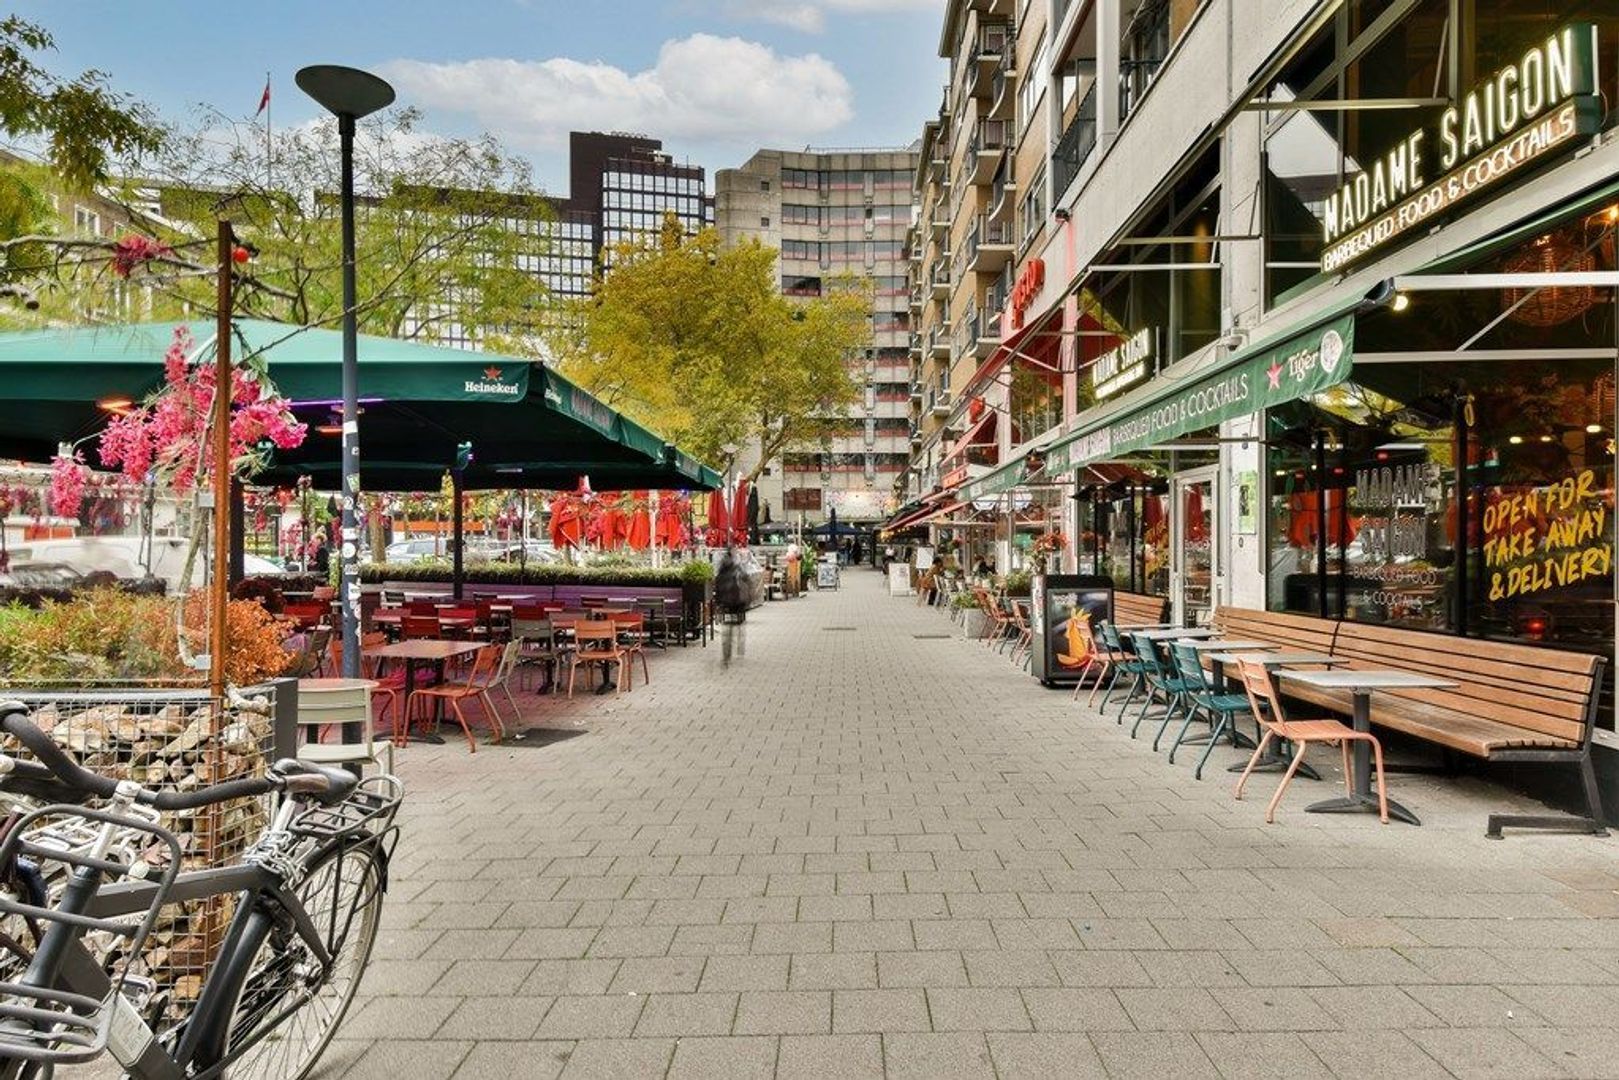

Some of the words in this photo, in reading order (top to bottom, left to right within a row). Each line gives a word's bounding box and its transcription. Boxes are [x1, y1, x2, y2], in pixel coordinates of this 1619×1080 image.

[1323, 129, 1424, 244] MADAME
[1441, 27, 1573, 170] SAIGON
[1323, 216, 1395, 273] BARBEQUED
[1399, 186, 1443, 230] FOOD
[1447, 176, 1461, 199] &
[1463, 105, 1575, 191] COCKTAILS
[464, 381, 519, 395] Heineken
[1288, 349, 1318, 382] Tiger
[1151, 402, 1178, 430] FOOD
[1179, 399, 1186, 420] &
[1187, 373, 1249, 418] COCKTAILS
[1356, 463, 1432, 508] MADAME
[1483, 489, 1538, 534] OPEN
[1546, 470, 1596, 514] FOR
[1361, 516, 1426, 559] SAIGON
[1483, 527, 1535, 567] TAKE
[1545, 506, 1605, 553] AWAY
[1406, 568, 1437, 585] FOOD
[1489, 572, 1504, 601] &
[1507, 544, 1611, 597] DELIVERY
